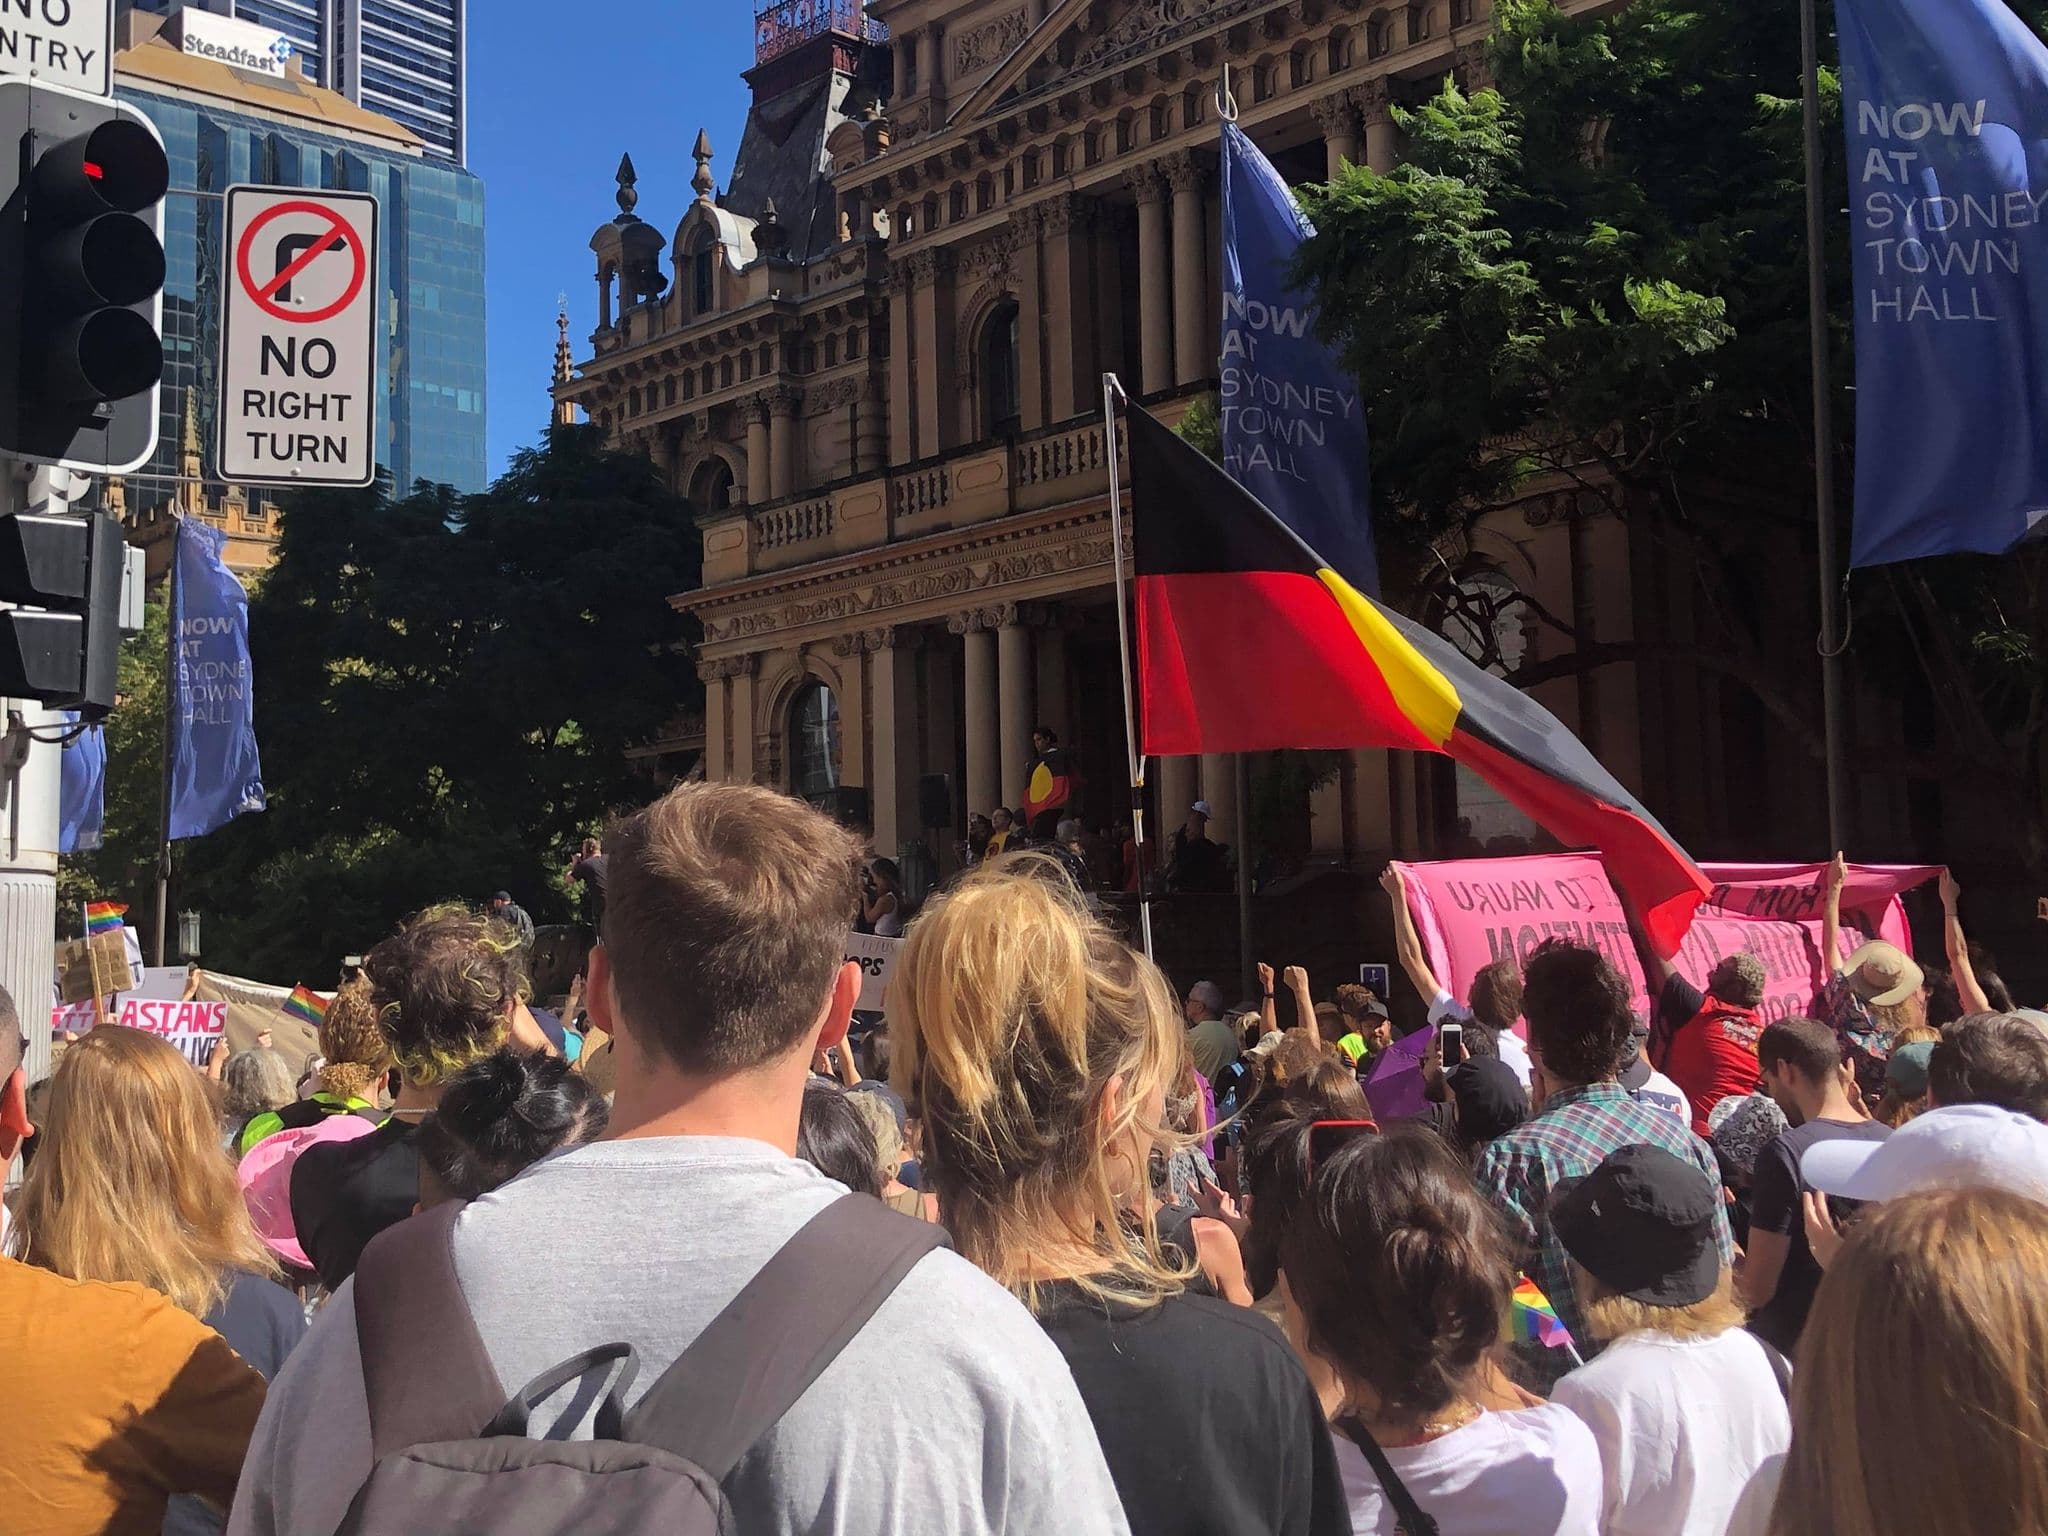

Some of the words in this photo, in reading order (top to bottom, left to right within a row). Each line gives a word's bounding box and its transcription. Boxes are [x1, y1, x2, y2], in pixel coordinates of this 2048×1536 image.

[0, 27, 96, 75] NTRY
[184, 33, 276, 72] Steadfast
[1858, 100, 1986, 140] NOW
[1862, 148, 1917, 184] AT
[1866, 191, 2048, 232] SYDNEY
[1865, 238, 2019, 276] TOWN
[1223, 291, 1321, 338] NOW
[1871, 285, 1997, 322] HALL
[260, 335, 337, 379] NO
[1221, 329, 1258, 362] AT
[243, 389, 352, 422] RIGHT
[1221, 367, 1354, 419] SYDNEY
[1221, 406, 1325, 446] TOWN
[247, 432, 347, 463] TURN
[1223, 443, 1308, 482] HALL
[180, 617, 235, 636] NOW
[180, 640, 203, 658] AT
[180, 659, 246, 681] SYDNE
[181, 683, 244, 703] TOWN
[182, 706, 232, 725] HALL
[120, 1001, 226, 1034] ASIANS
